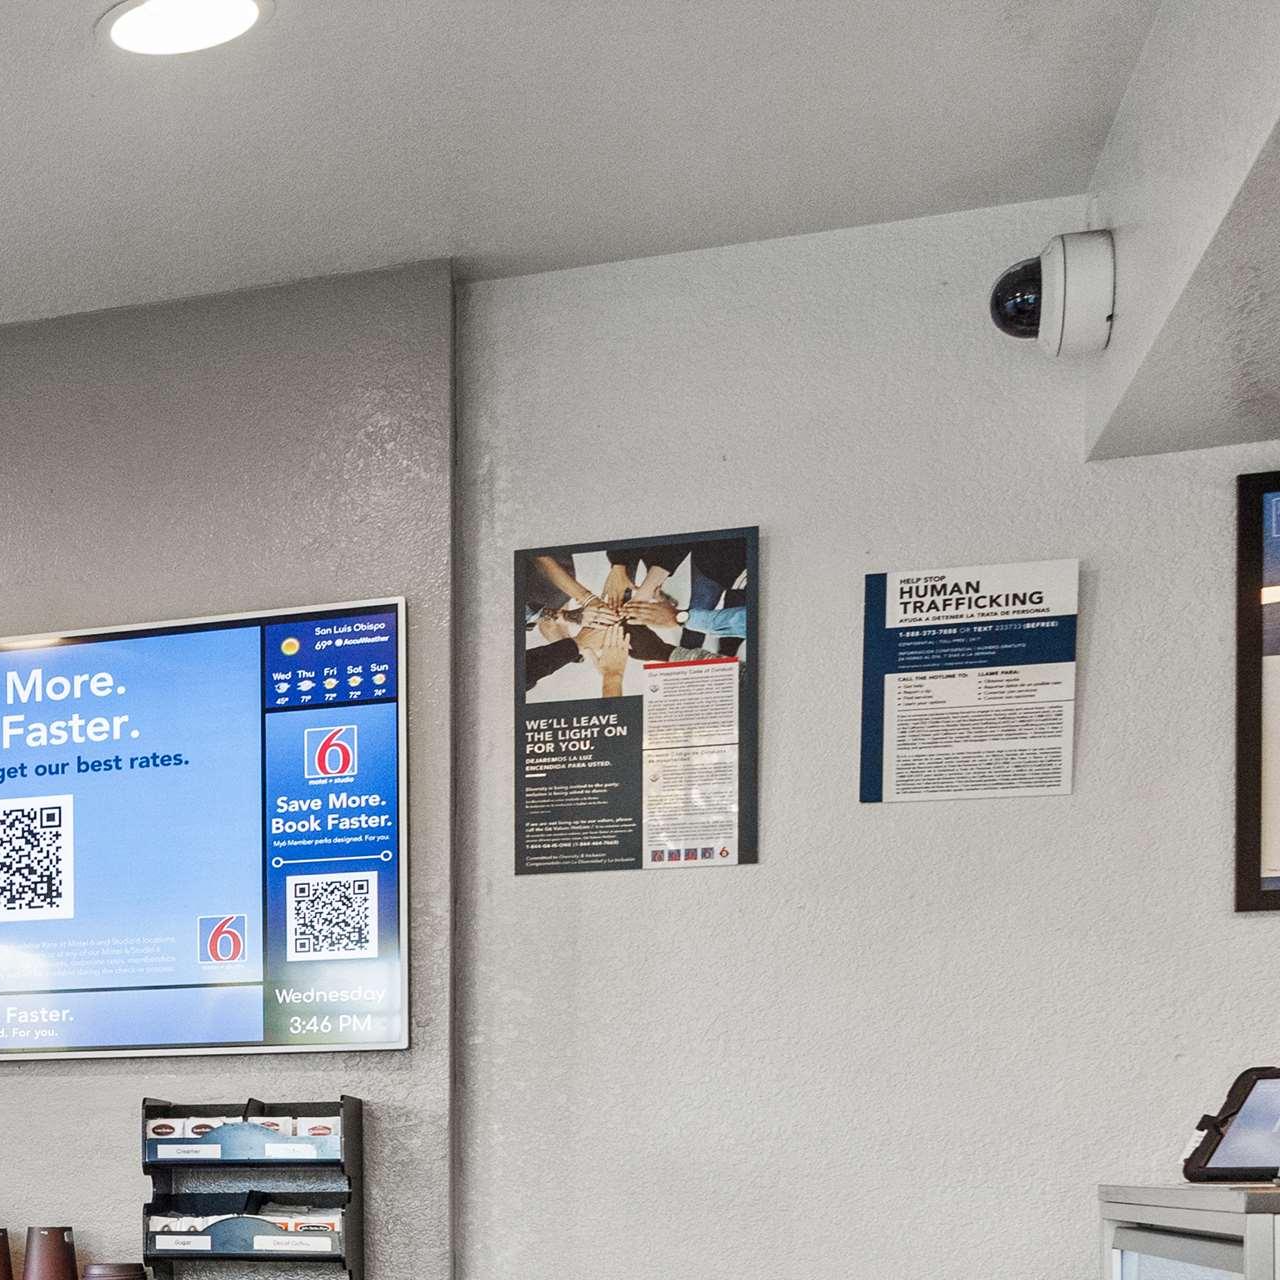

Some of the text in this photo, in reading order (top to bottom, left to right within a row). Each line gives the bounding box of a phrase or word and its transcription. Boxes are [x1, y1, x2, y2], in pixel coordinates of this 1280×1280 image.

[899, 581, 980, 599] HUMAN
[900, 591, 1044, 614] TRAFFICKING
[315, 622, 385, 635] San Luis Obispo
[272, 664, 388, 680] Wed Thu Fri Sat Sun
[5, 669, 126, 705] More.
[2, 713, 140, 748] Faster.
[525, 714, 618, 730] WE'LL LEAVE
[525, 726, 627, 742] THE LIGHT ON
[315, 727, 353, 776] 6
[526, 740, 594, 753] FOR YOU.
[34, 759, 69, 777] our
[76, 754, 122, 773] best
[129, 752, 189, 769] rates.
[525, 756, 566, 764] DEJAREMOS
[276, 792, 386, 813] Save More.
[272, 814, 392, 834] Book Faster.
[208, 915, 244, 962] 6
[275, 988, 386, 1004] Wednesday
[6, 1007, 74, 1023] Faster.
[289, 1014, 372, 1034] 3:46 PM
[12, 1028, 31, 1038] For
[33, 1029, 58, 1041] you.
